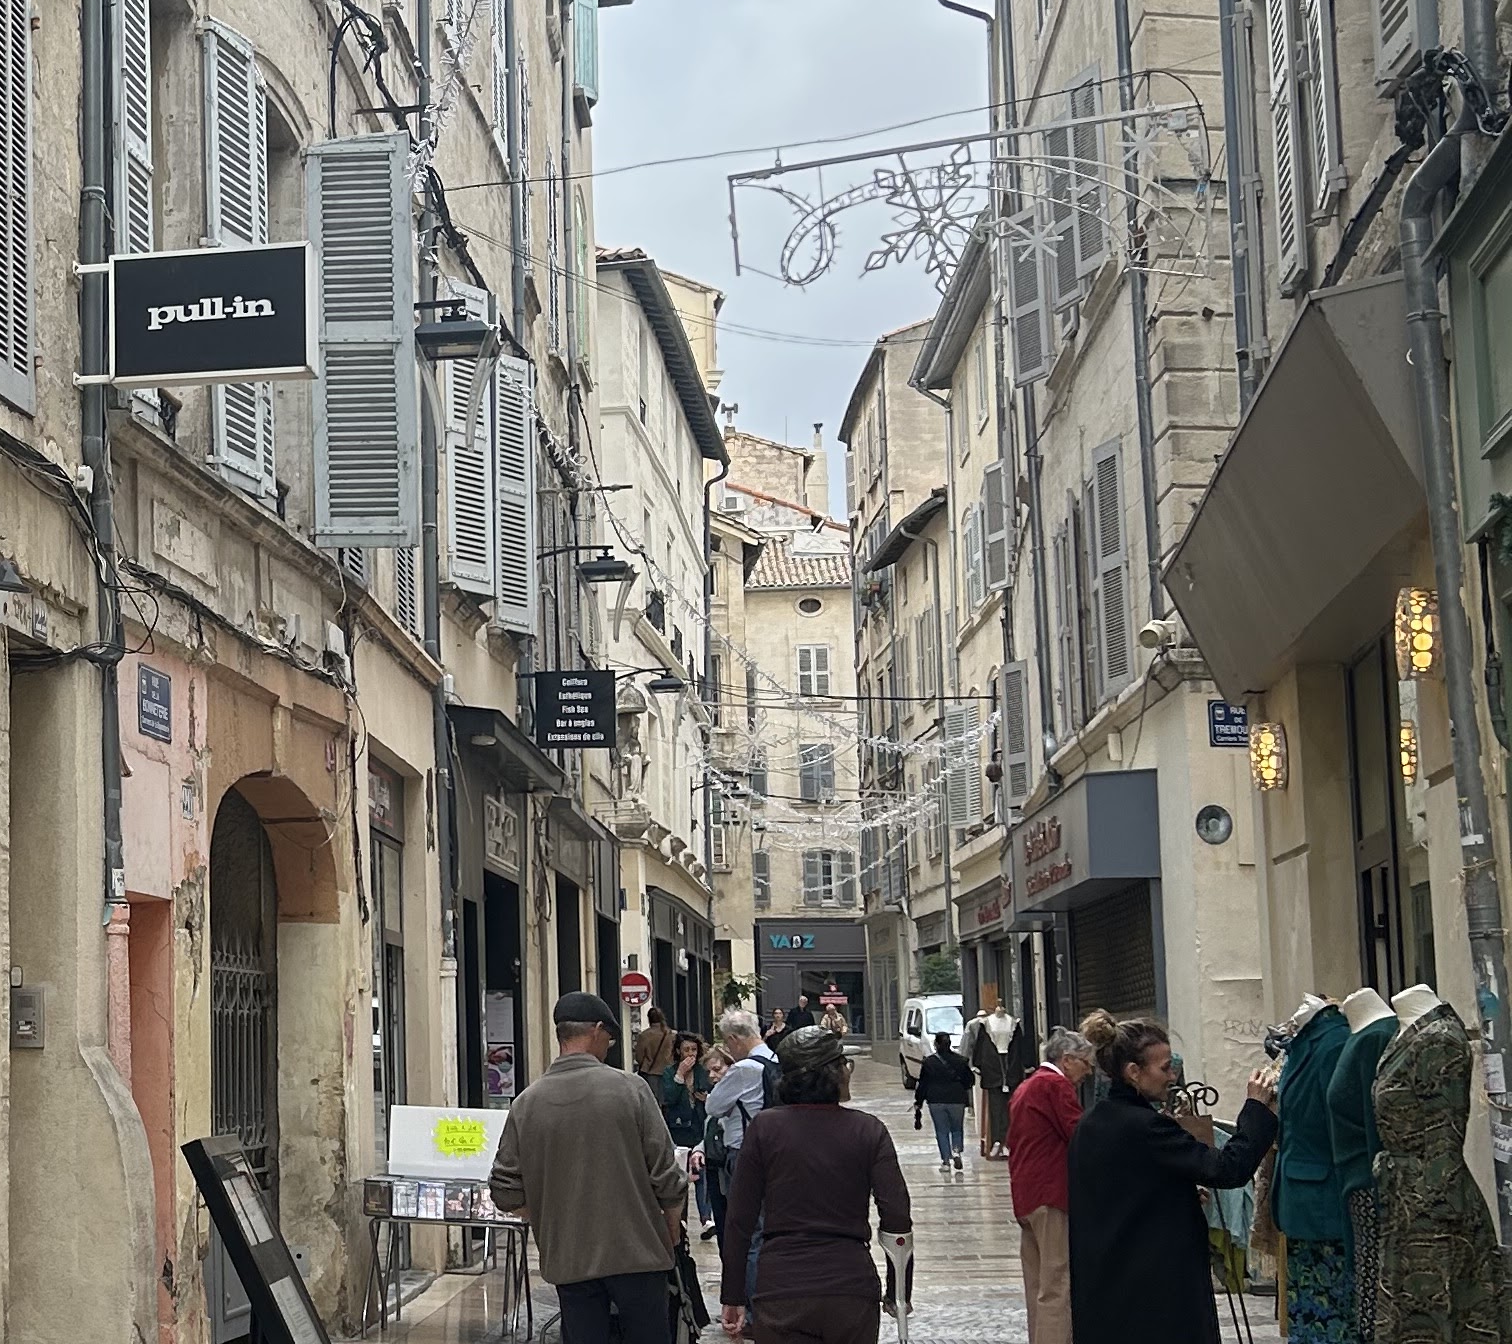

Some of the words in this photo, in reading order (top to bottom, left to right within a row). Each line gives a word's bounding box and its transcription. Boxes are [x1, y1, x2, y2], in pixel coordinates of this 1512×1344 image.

[147, 295, 275, 331] pull-in
[562, 705, 575, 713] Fish
[577, 705, 588, 713] Spa
[556, 719, 567, 727] Bar
